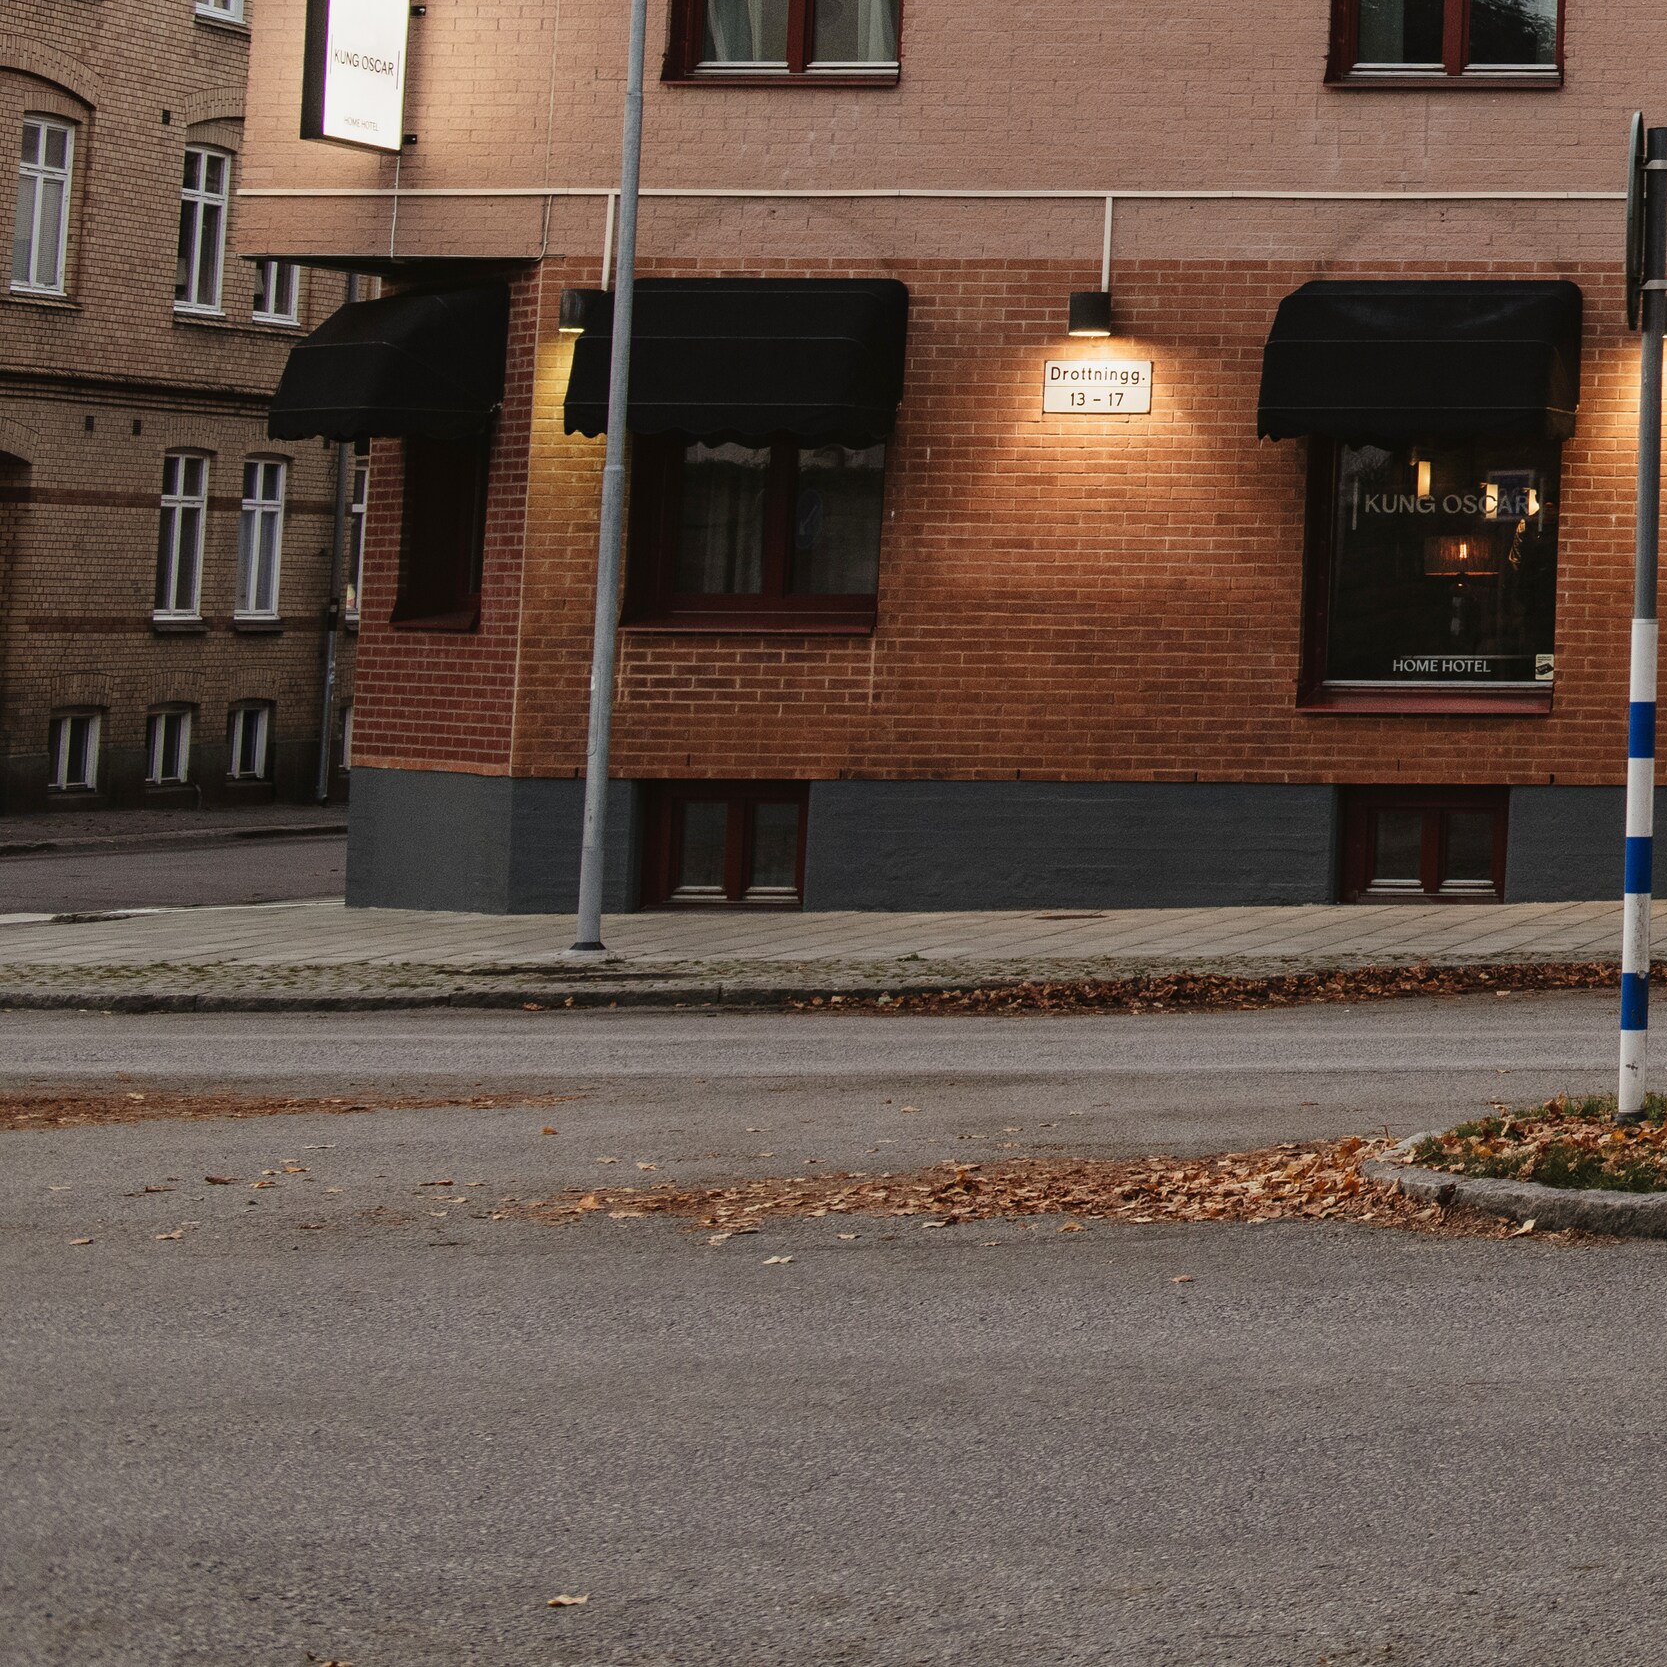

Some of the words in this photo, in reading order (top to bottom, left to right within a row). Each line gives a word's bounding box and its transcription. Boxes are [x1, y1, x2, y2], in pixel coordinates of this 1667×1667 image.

[334, 48, 360, 68] KUNG
[361, 55, 394, 76] OSCAR
[344, 115, 360, 128] HOME
[361, 120, 379, 132] HOTEL
[1050, 366, 1146, 385] Drottningg.
[1070, 392, 1086, 407] 13
[1108, 392, 1124, 407] 17
[1364, 494, 1436, 514] KUNG
[1442, 494, 1530, 515] OSCAR
[1392, 659, 1438, 672] HOME
[1442, 660, 1491, 673] HOTEL
